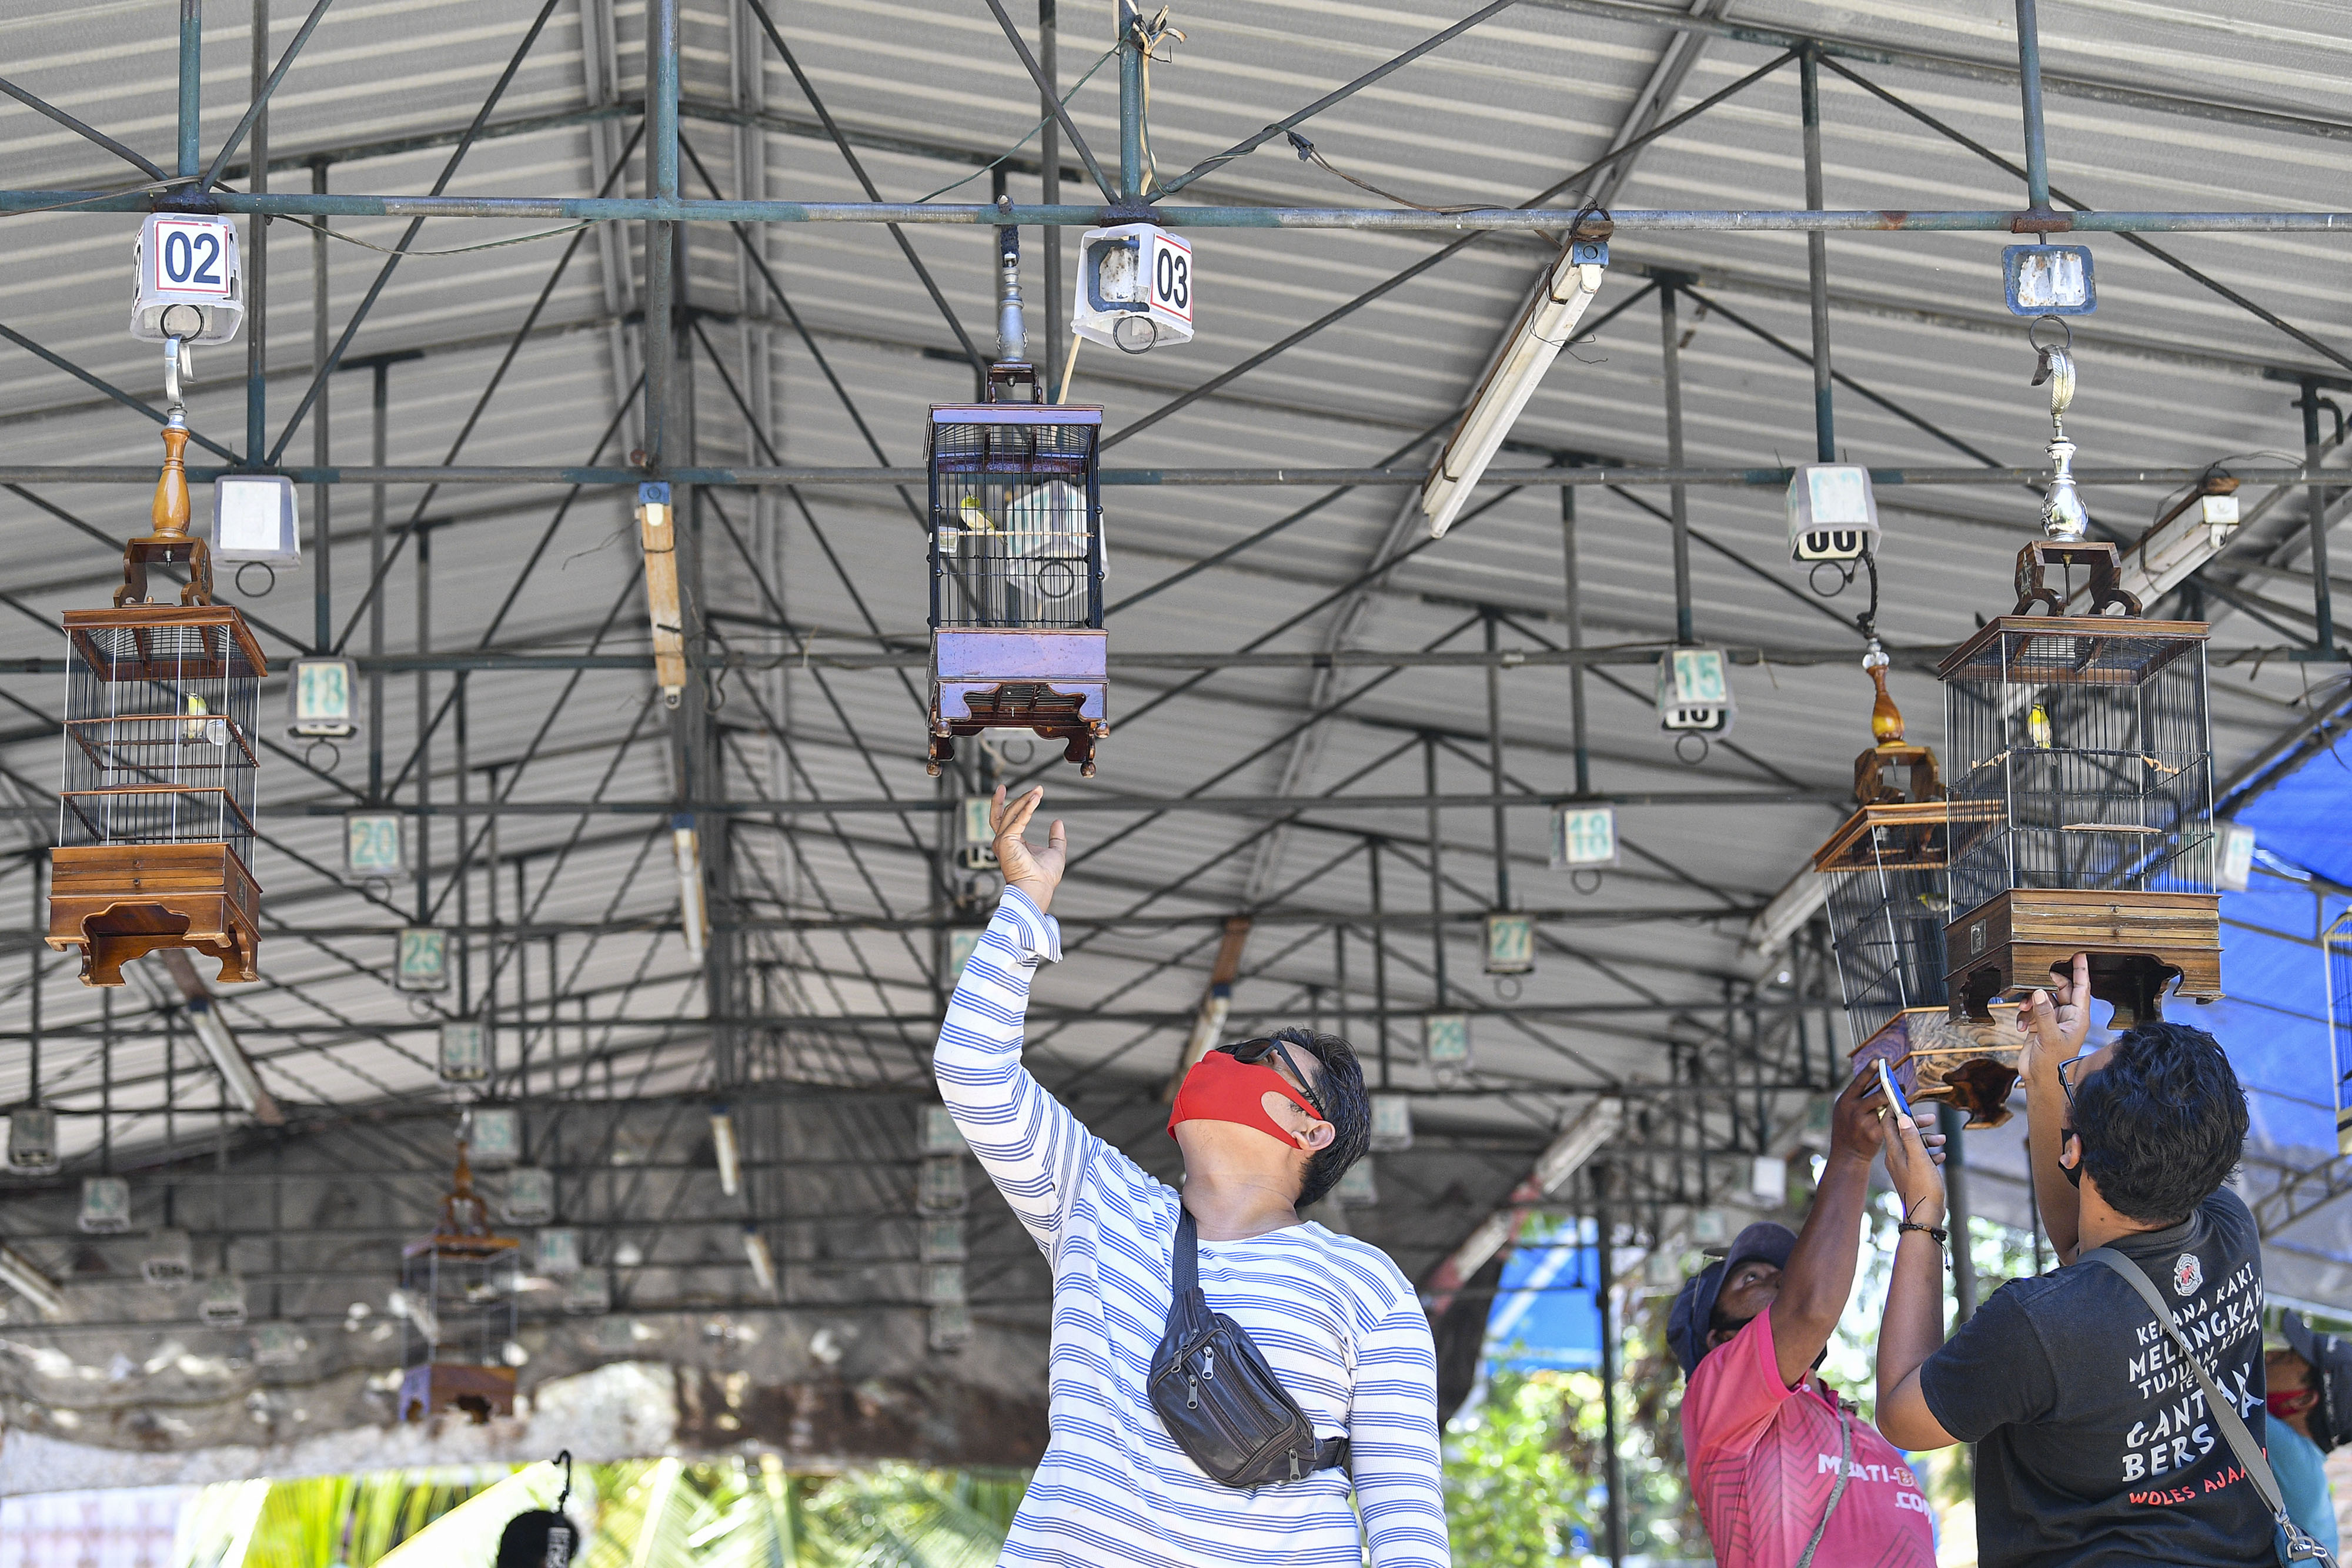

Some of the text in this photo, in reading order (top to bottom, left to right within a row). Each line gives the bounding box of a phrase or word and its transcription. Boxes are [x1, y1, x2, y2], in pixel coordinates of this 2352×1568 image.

[165, 231, 220, 284] 02
[1158, 248, 1188, 309] 03
[1677, 655, 1722, 698] 15
[353, 821, 395, 864] 20
[404, 933, 442, 972] 25
[2216, 1262, 2254, 1304] KAKI
[2129, 1277, 2263, 1382] MELANGKAH
[2219, 1313, 2259, 1352] KITA
[2129, 1486, 2196, 1506] WOLES
